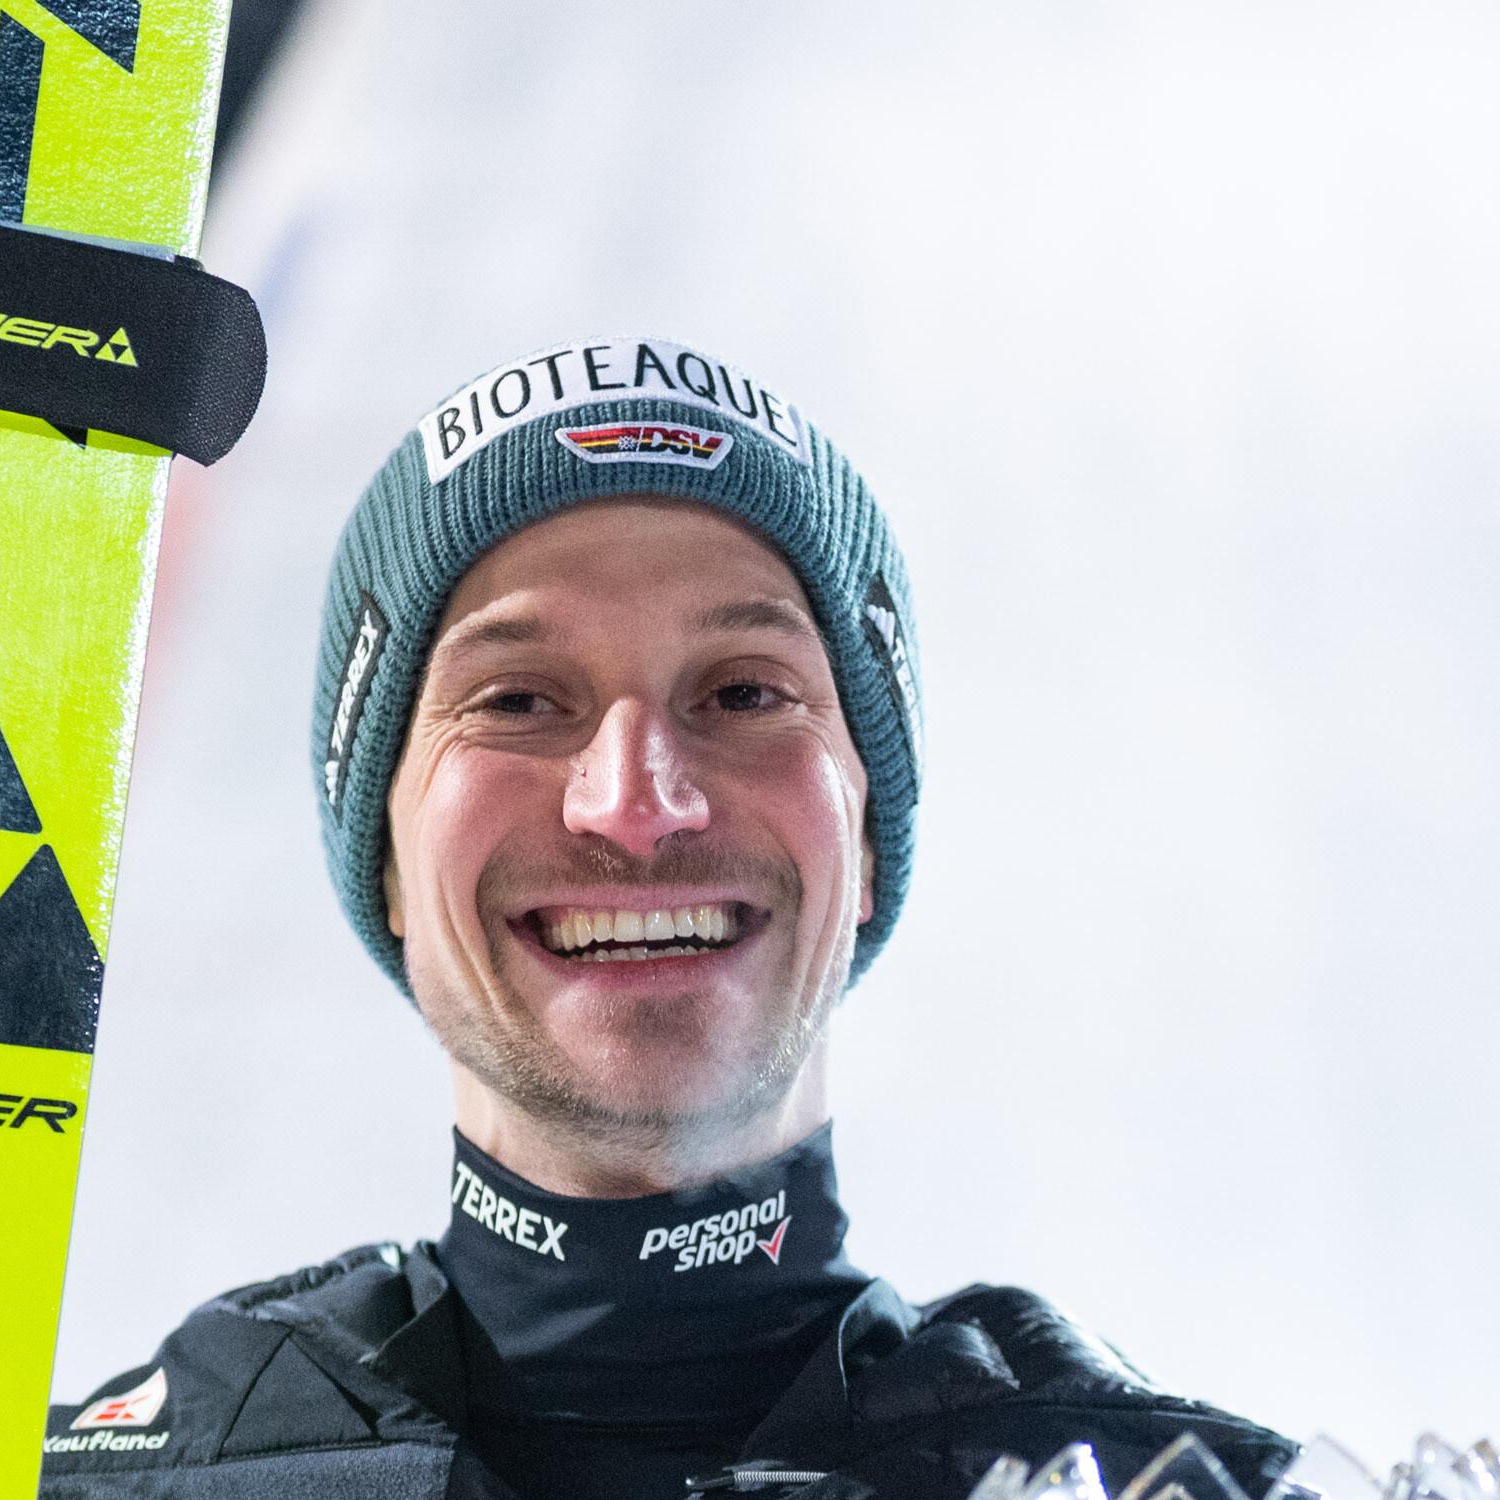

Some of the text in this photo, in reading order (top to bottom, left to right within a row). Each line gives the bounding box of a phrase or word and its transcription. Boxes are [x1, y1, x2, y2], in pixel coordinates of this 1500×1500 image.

[434, 343, 800, 460] BIOTEAQUE
[638, 426, 724, 460] DSV
[451, 1161, 569, 1262] TERREX
[638, 1189, 787, 1261] personal
[674, 1228, 757, 1273] shop
